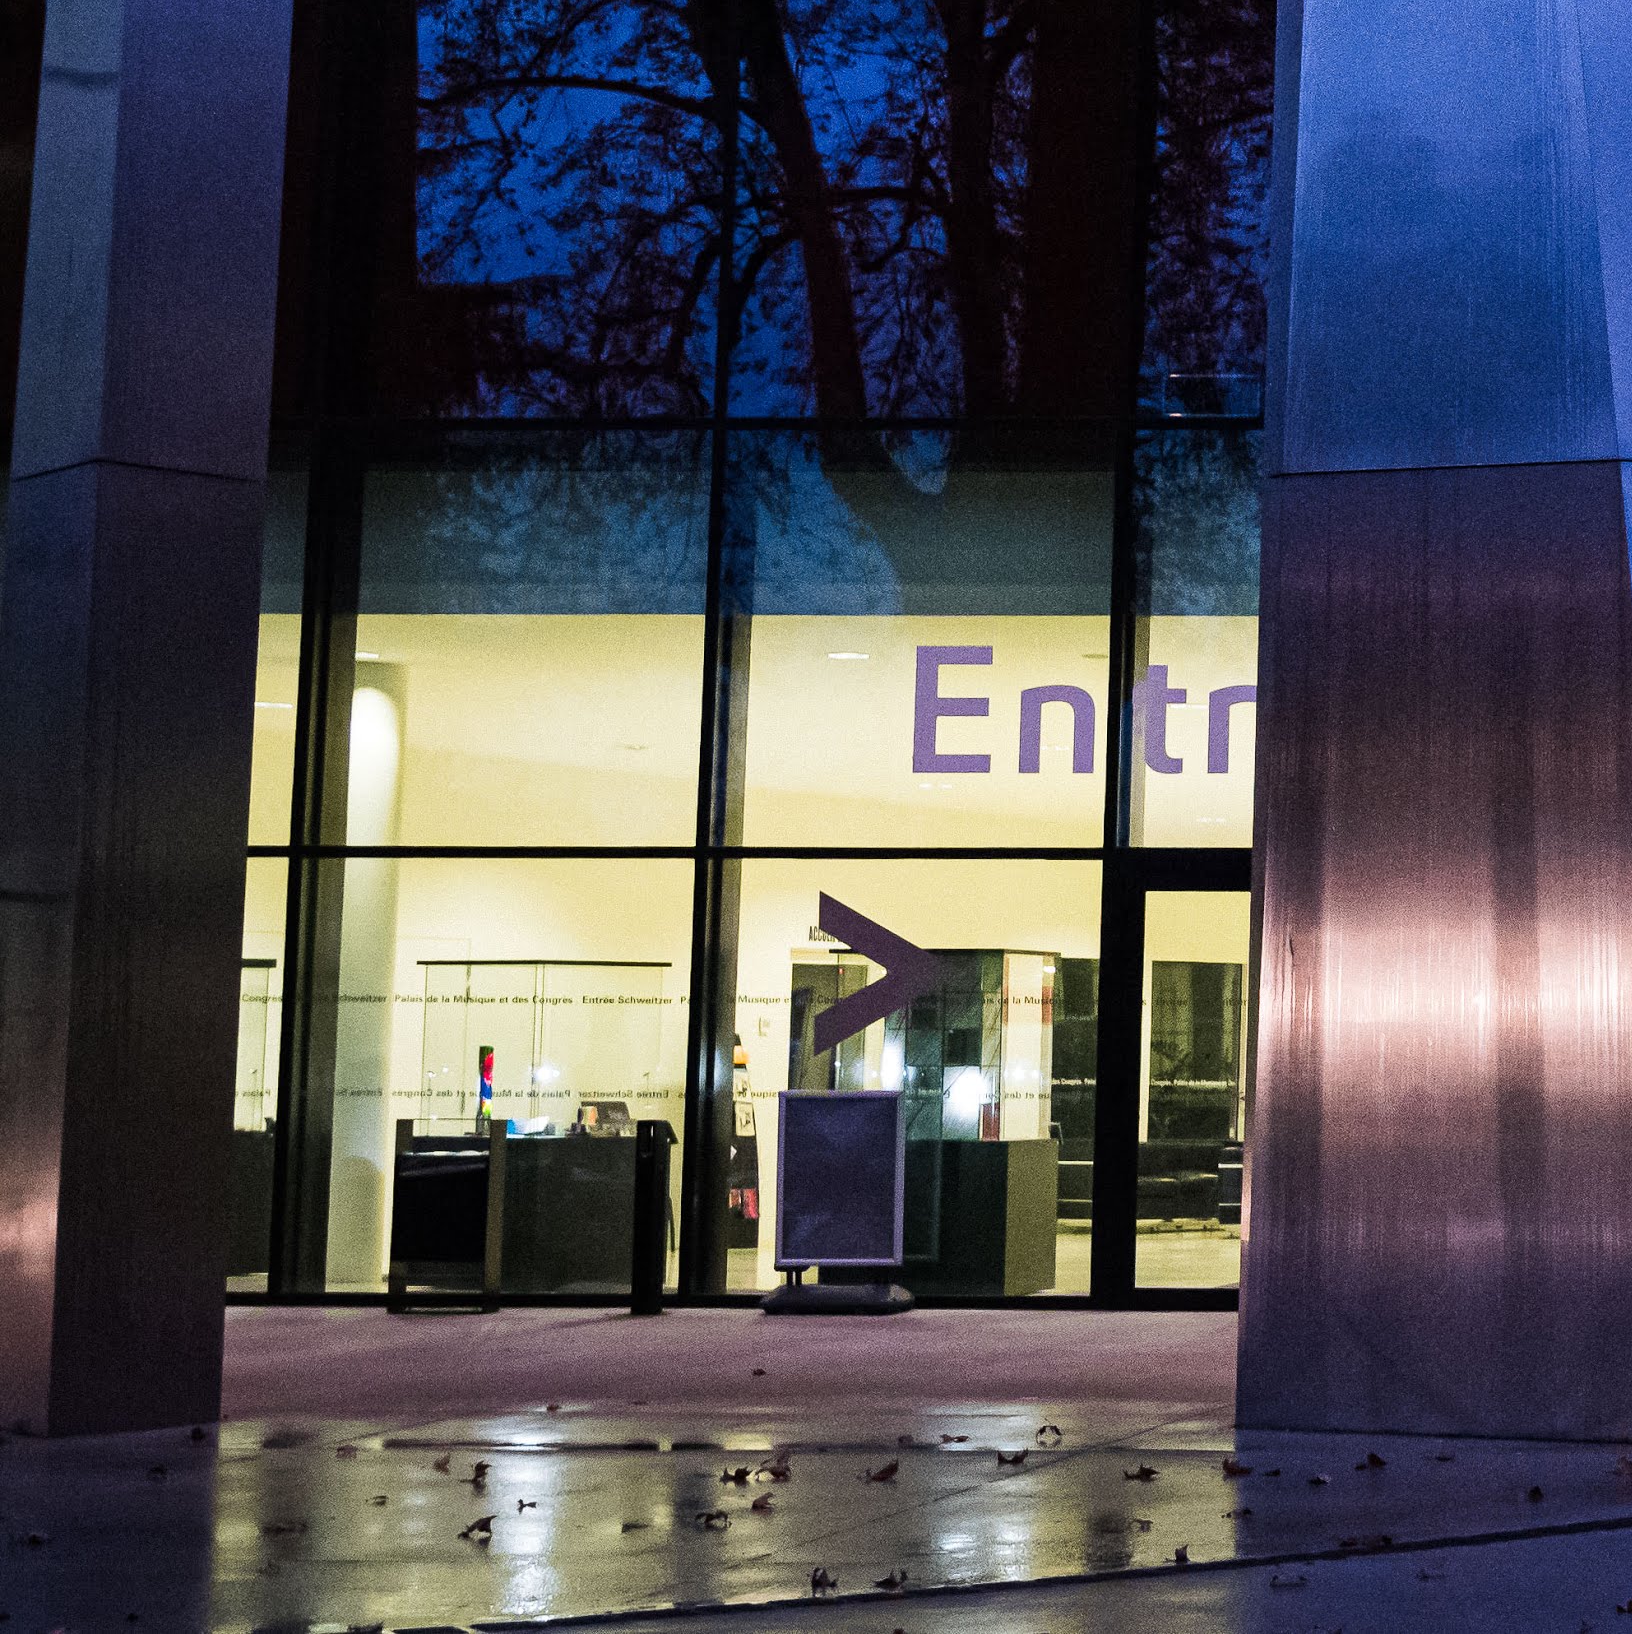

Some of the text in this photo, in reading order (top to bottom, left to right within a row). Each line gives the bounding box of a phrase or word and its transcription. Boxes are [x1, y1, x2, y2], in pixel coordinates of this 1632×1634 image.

[912, 645, 1258, 774] Entr
[499, 995, 509, 1004] et
[512, 994, 530, 1004] des
[617, 995, 674, 1006] Schweitzer
